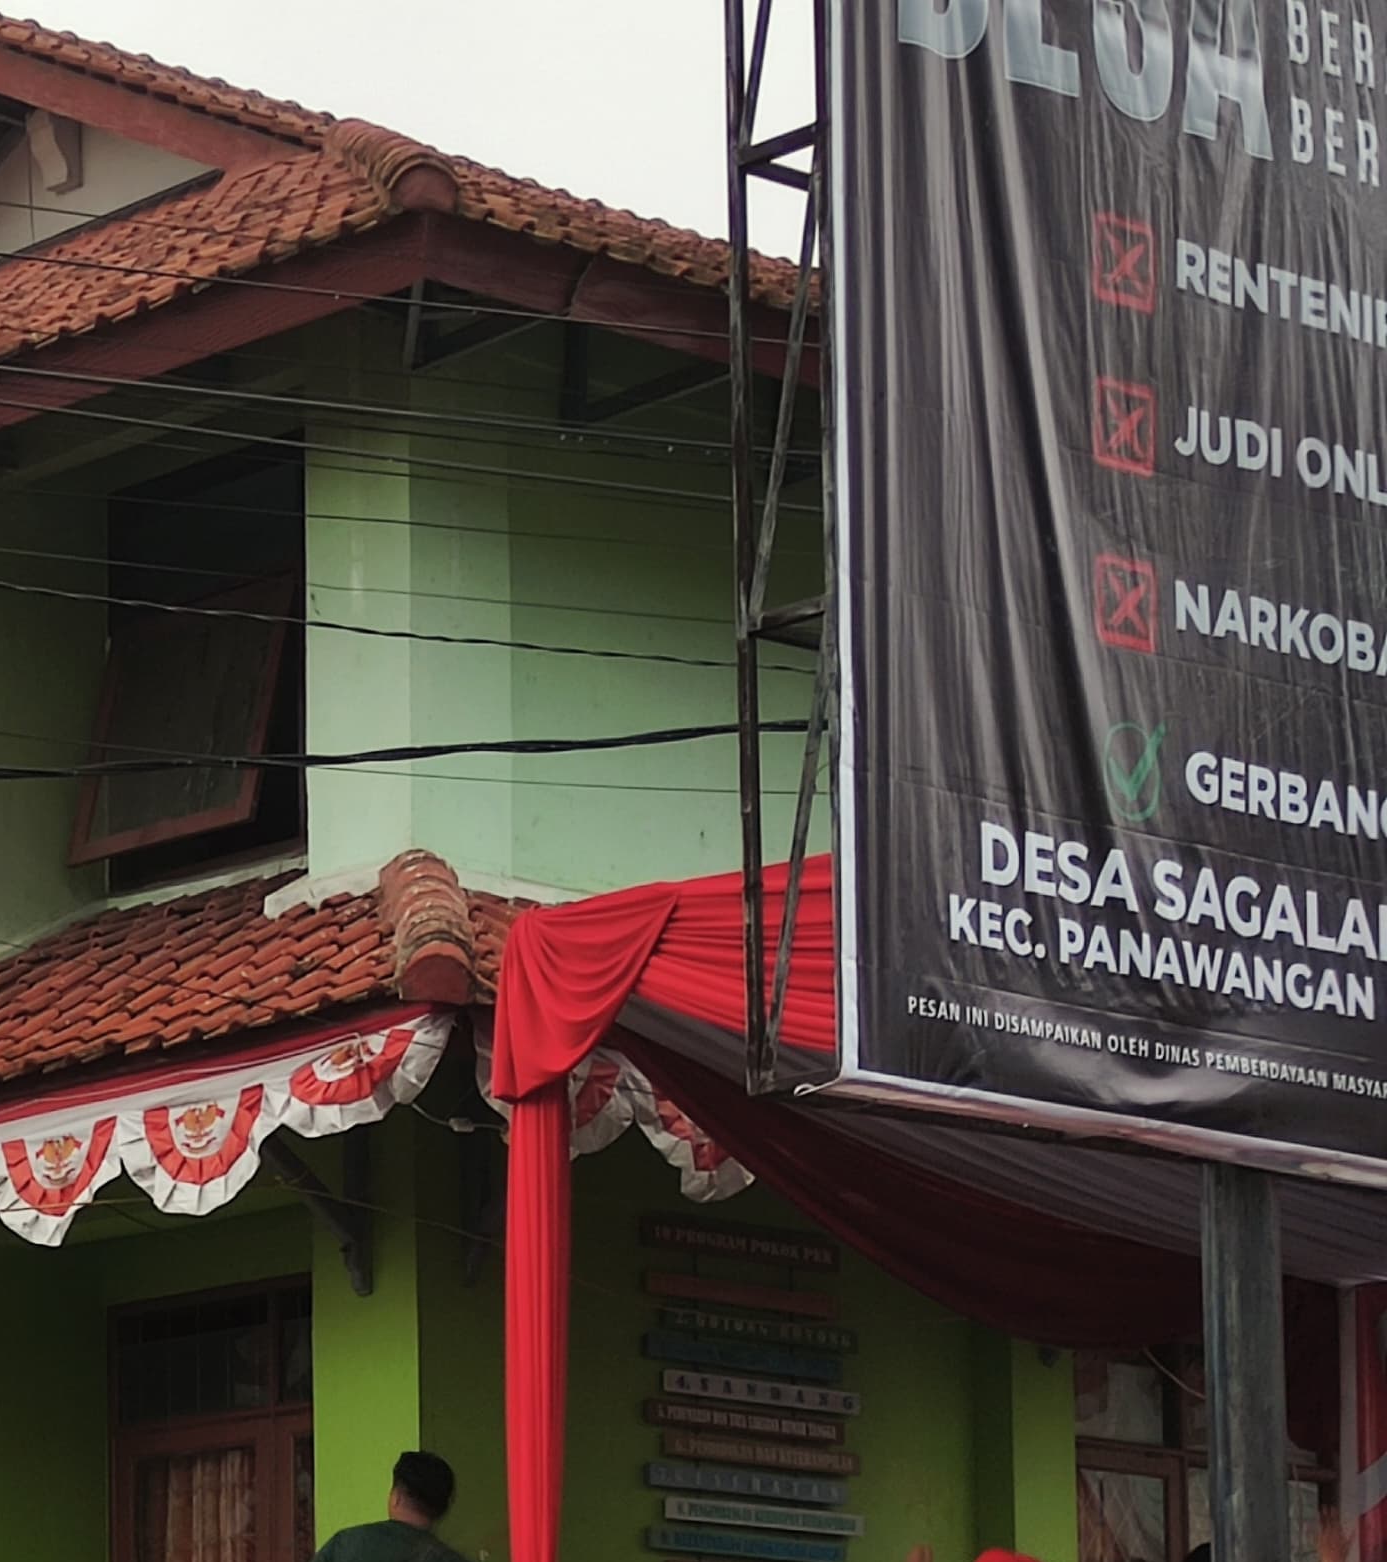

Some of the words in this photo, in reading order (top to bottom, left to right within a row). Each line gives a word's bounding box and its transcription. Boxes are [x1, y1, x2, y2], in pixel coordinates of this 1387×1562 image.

[1286, 0, 1387, 89] BER
[1174, 406, 1282, 478] JUDI
[1296, 437, 1387, 506] ONL
[1185, 752, 1387, 840] GERBAN
[981, 821, 1139, 912] DESA
[949, 893, 1046, 958] KEC.
[1059, 917, 1375, 1021] PANAWANGAN
[907, 996, 961, 1022] PESAN
[966, 1006, 989, 1027] INI
[994, 1012, 1102, 1049] DISAMPAIKAN
[1107, 1034, 1149, 1058] OLEH
[1155, 1042, 1200, 1067] DINAS
[1206, 1051, 1328, 1089] PEMBERDAYAAN
